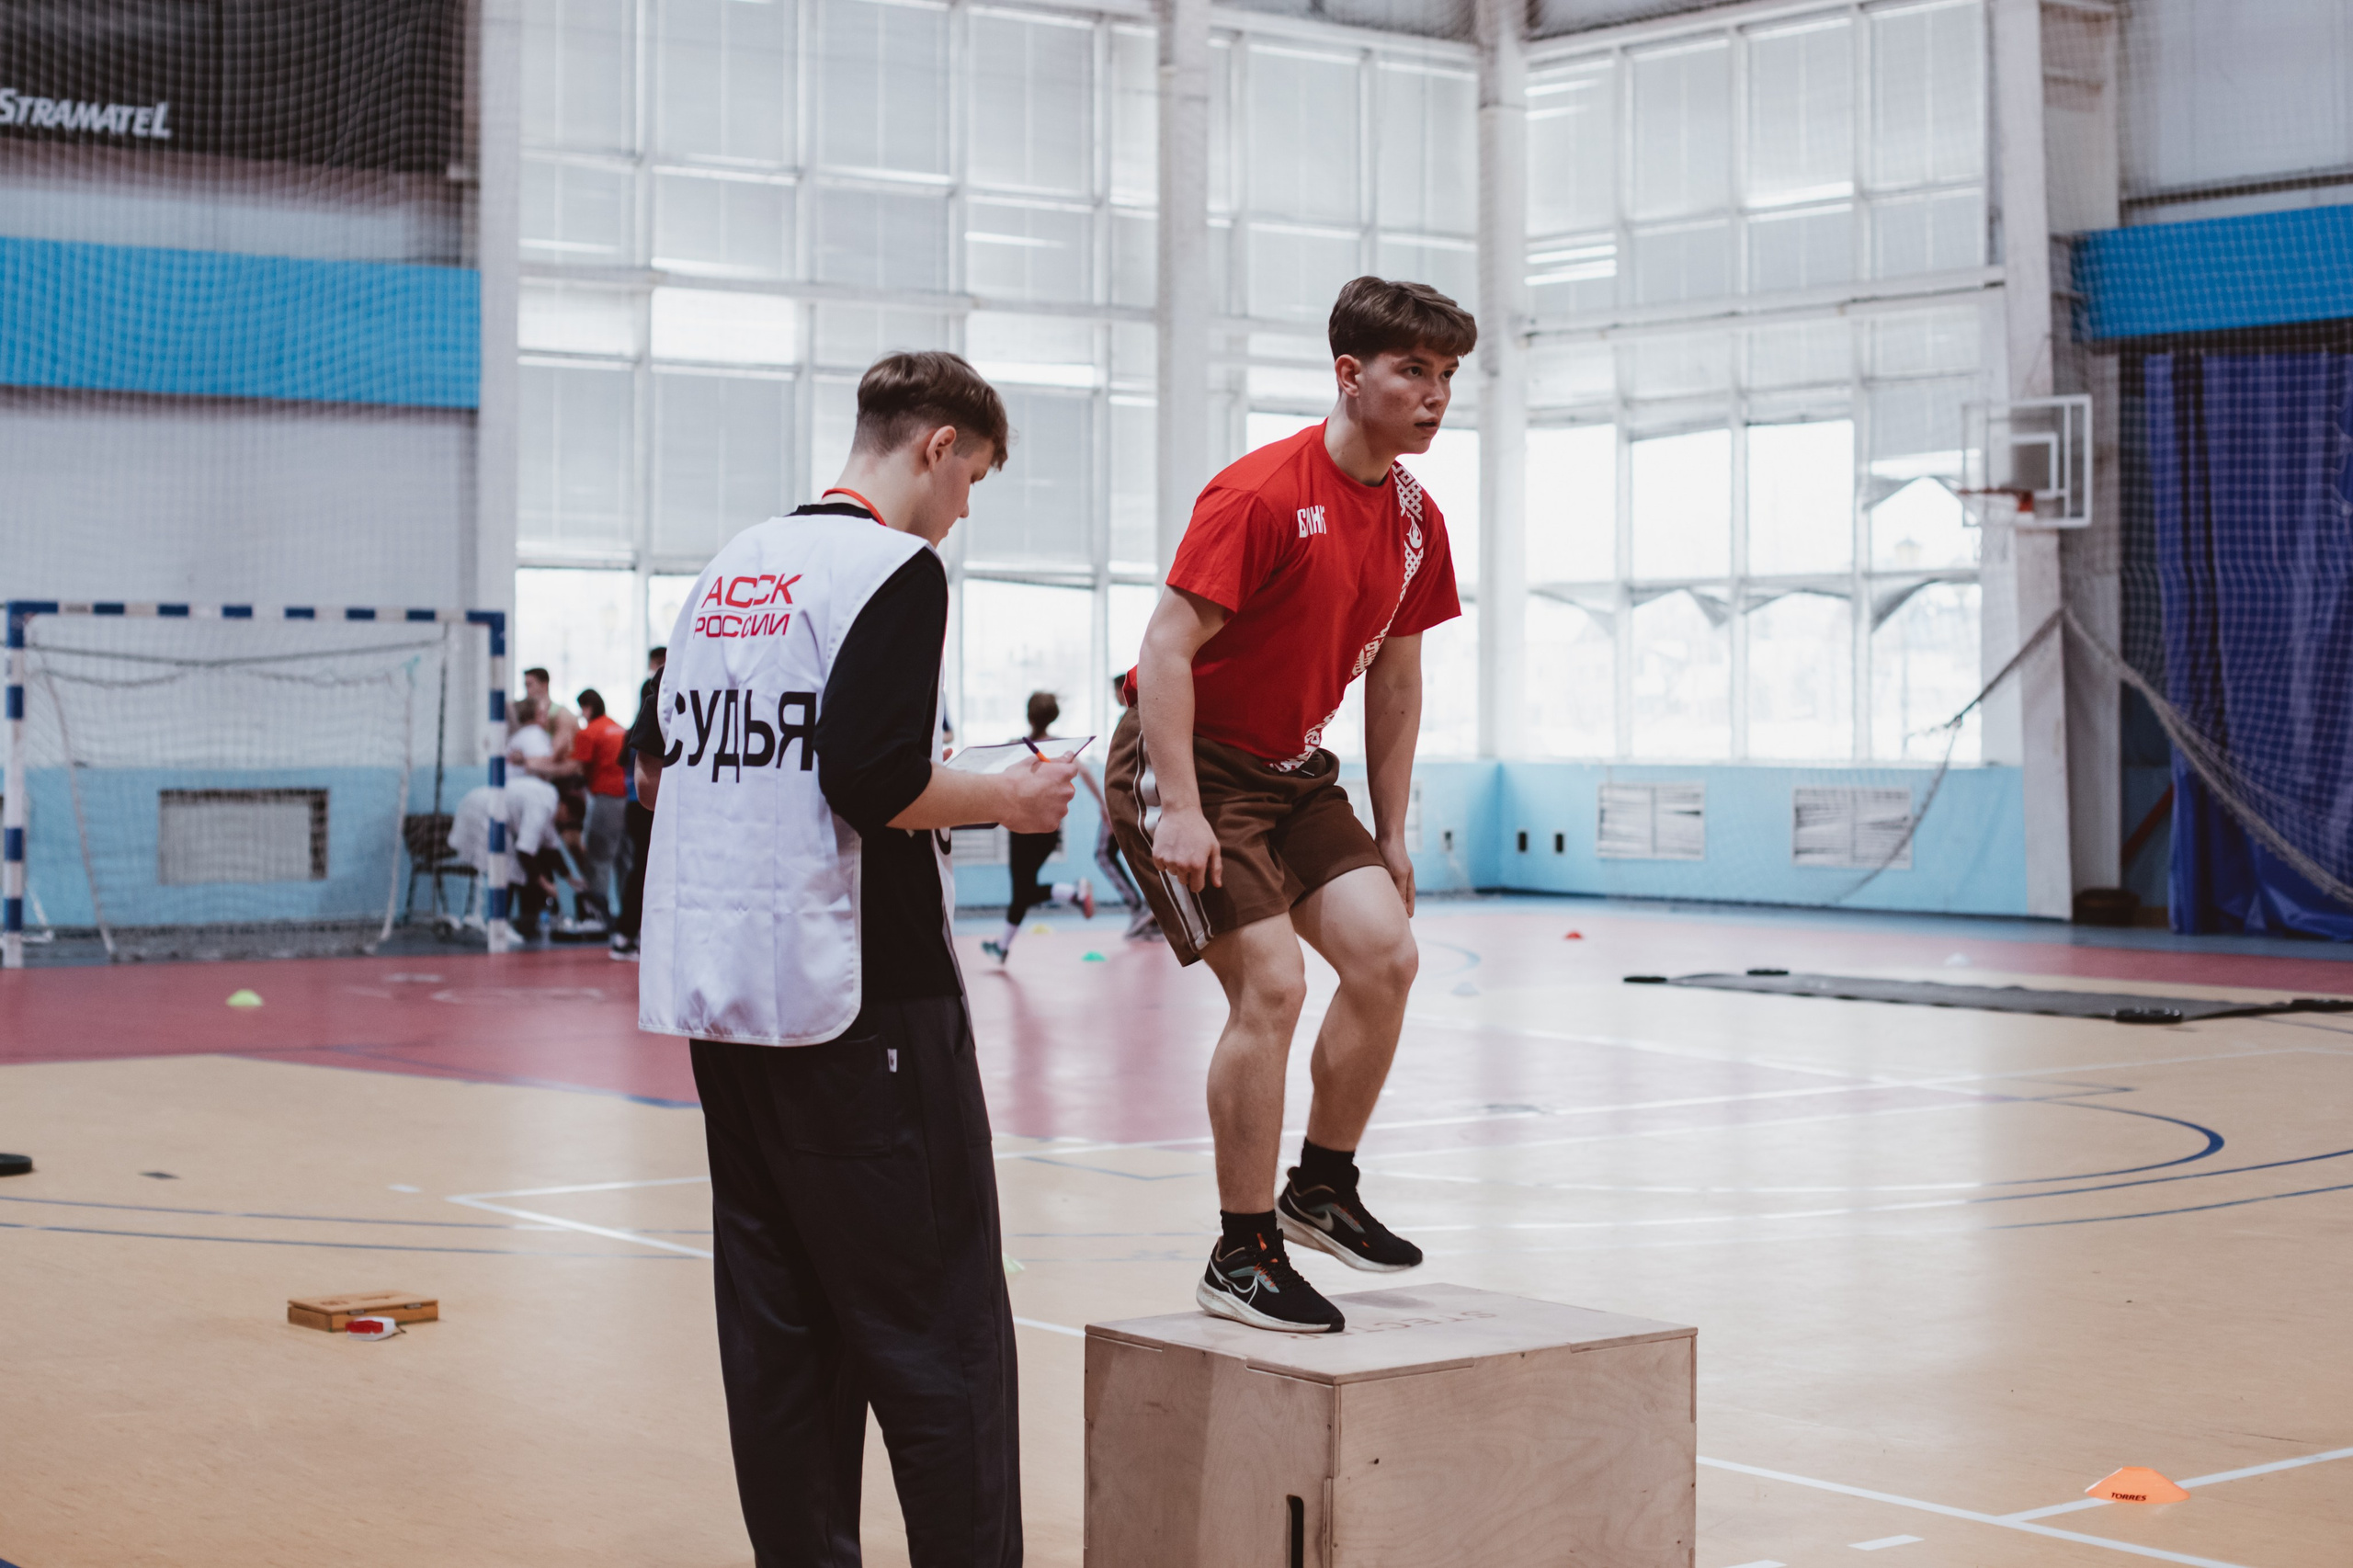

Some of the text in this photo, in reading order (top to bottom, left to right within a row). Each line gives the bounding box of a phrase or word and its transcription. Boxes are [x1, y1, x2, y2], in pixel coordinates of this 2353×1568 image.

[0, 87, 172, 138] STRAMATEL
[701, 573, 803, 608] АССК
[693, 613, 790, 639] РОССИИ
[662, 689, 817, 784] СУДЬЯ
[2110, 1492, 2147, 1502] TORRES
